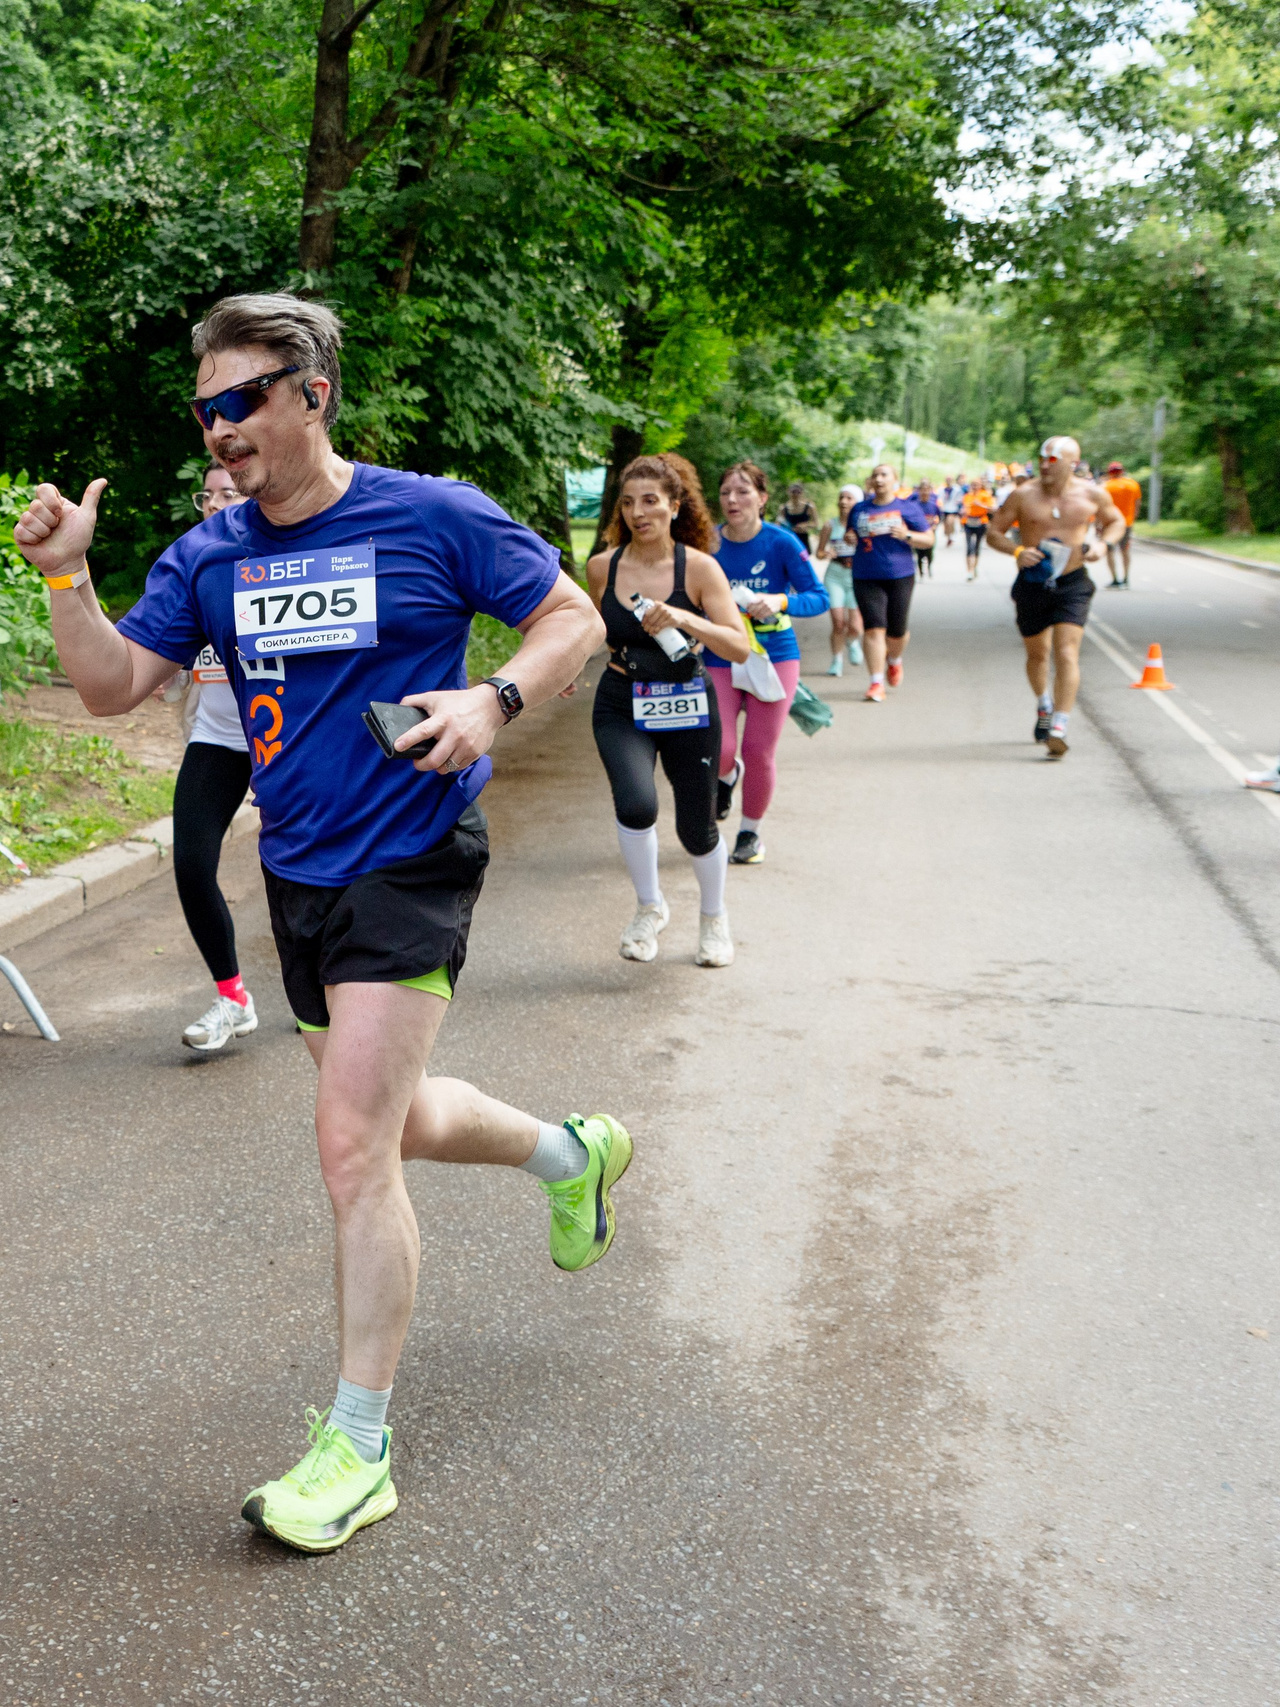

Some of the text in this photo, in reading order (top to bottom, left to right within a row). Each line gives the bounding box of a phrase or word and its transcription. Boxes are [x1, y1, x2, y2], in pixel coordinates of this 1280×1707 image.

[331, 556, 353, 565] Парк
[331, 562, 369, 572] Горького
[250, 587, 357, 626] 1705
[262, 632, 349, 649] 10КМ КЛАСТЕР А
[642, 698, 698, 716] 2381
